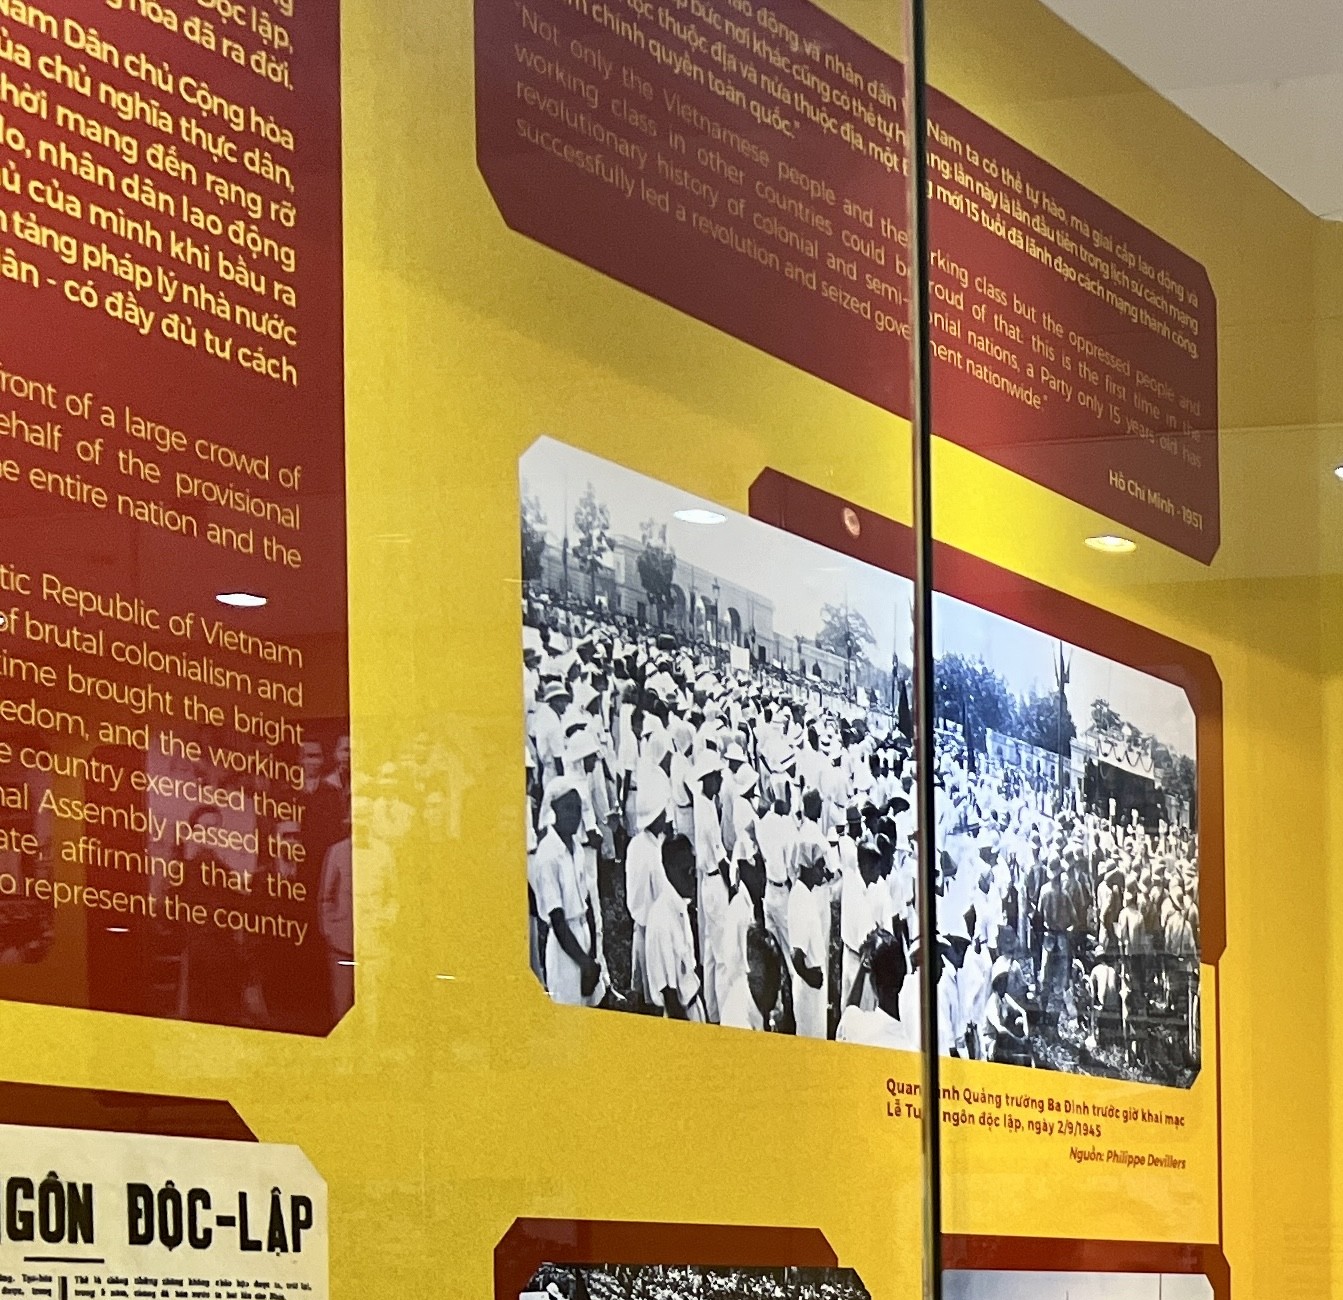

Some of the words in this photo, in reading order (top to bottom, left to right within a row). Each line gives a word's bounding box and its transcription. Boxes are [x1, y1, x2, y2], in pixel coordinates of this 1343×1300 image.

[64, 21, 119, 67] Dân
[125, 55, 173, 93] chủ
[180, 75, 245, 134] Cộng
[250, 106, 293, 150] hòa
[56, 109, 138, 165] mang
[146, 138, 197, 183] đến
[206, 173, 262, 219] rạng
[270, 199, 296, 227] rỡ
[13, 216, 78, 268] tảng
[83, 246, 152, 296] pháp
[158, 267, 179, 307] lý
[183, 284, 231, 319] nhà
[236, 307, 297, 345] nước
[28, 181, 82, 218] của
[90, 209, 162, 251] mình
[170, 232, 210, 272] khi
[219, 252, 265, 294] bầu
[273, 283, 296, 307] ra
[64, 280, 98, 309] có
[105, 288, 155, 338] đầy
[162, 310, 197, 347] đủ
[204, 330, 232, 361] tư
[238, 346, 297, 386] cách
[929, 249, 969, 290] rking
[975, 273, 1007, 307] class
[1013, 292, 1036, 323] but
[1042, 311, 1064, 339] the
[1068, 330, 1130, 377] oppressed
[0, 413, 62, 453] ehalf
[76, 437, 104, 466] of
[118, 450, 160, 484] the
[176, 475, 300, 530] provisional
[66, 392, 93, 421] of
[100, 409, 116, 428] a
[125, 407, 187, 455] large
[195, 441, 269, 481] crowd
[278, 463, 301, 492] of
[1109, 468, 1125, 492] Hồ
[1127, 478, 1145, 502] Chí
[1148, 488, 1174, 517] Minh
[1182, 506, 1203, 531] 1951
[42, 576, 160, 630] Republic
[169, 612, 195, 639] of
[201, 619, 302, 668] Vietnam
[68, 666, 174, 715] brought
[184, 696, 224, 727] the
[234, 705, 304, 747] bright
[38, 791, 167, 843] Assembly
[175, 823, 258, 853] passed
[268, 834, 306, 862] the
[0, 1171, 94, 1244] GÔN
